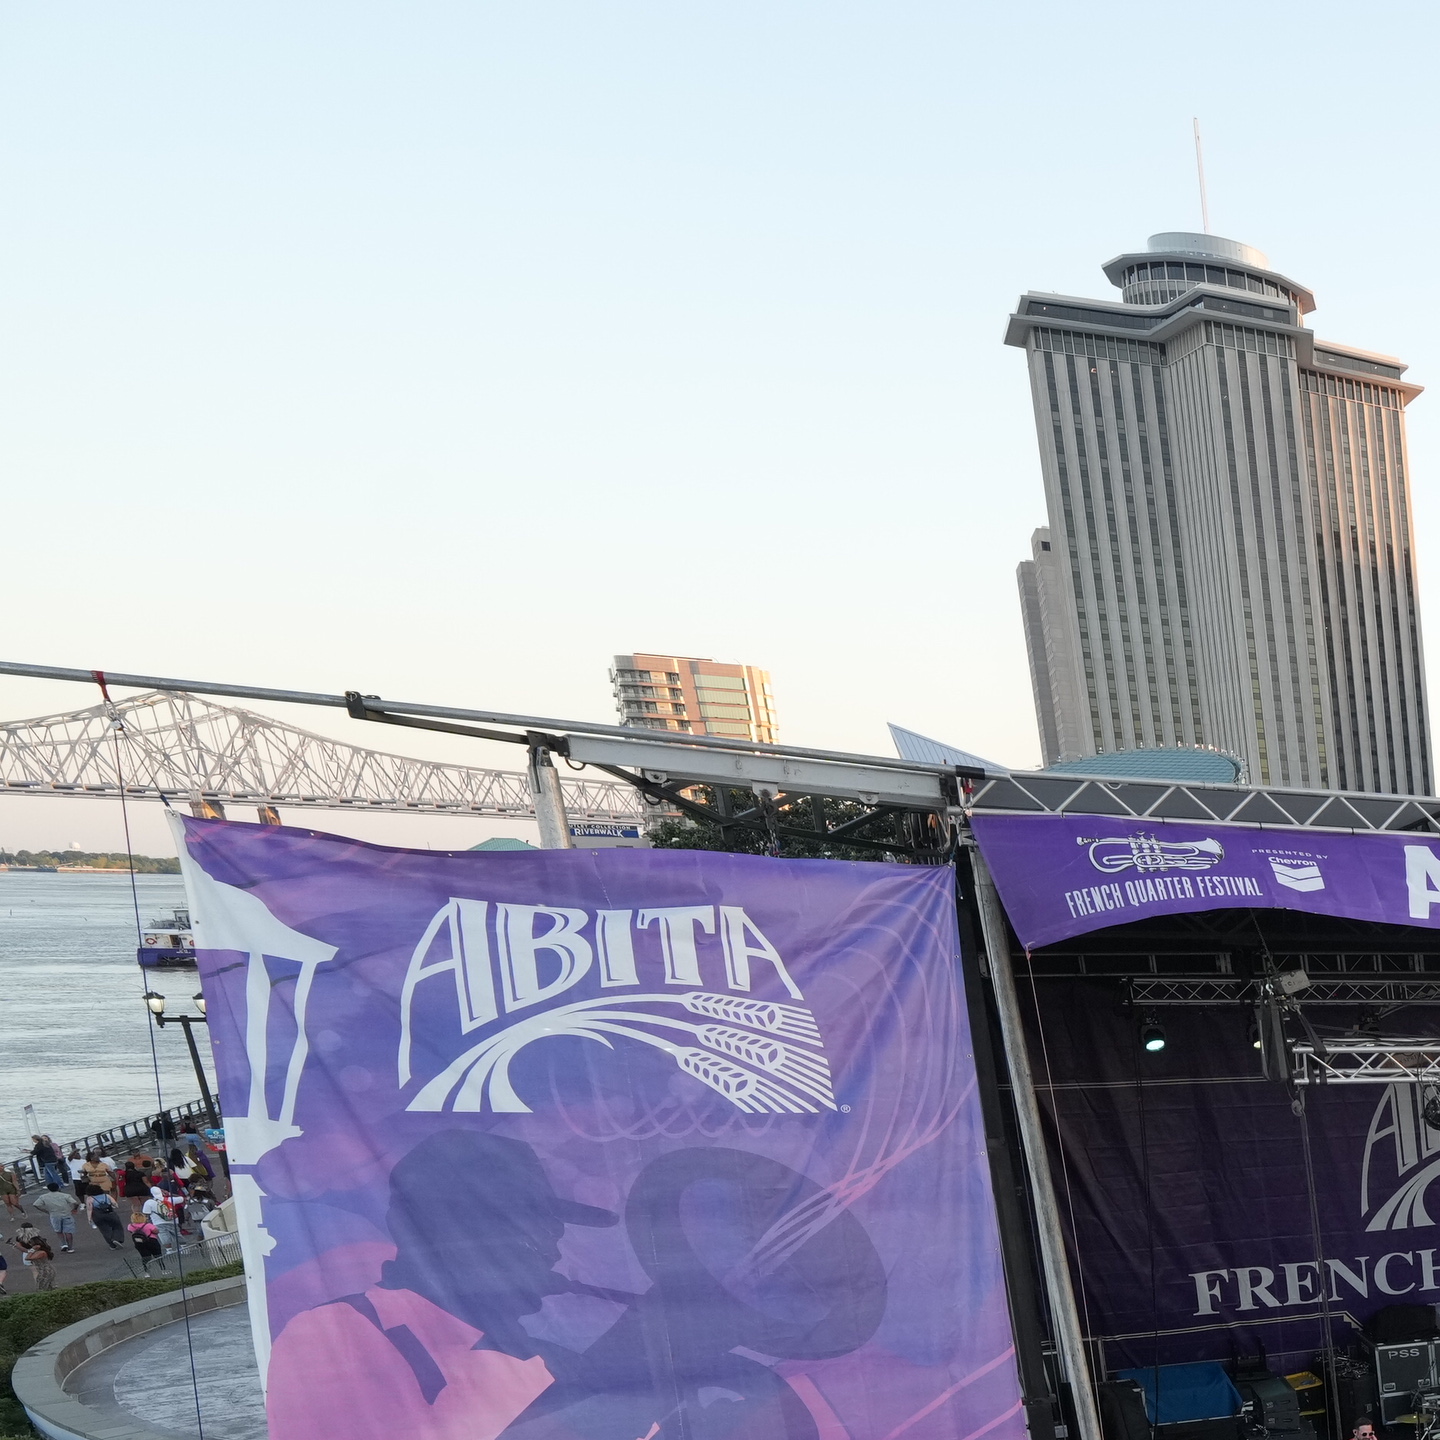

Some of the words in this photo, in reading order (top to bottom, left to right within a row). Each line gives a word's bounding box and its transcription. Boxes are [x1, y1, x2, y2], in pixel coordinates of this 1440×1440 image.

[574, 828, 624, 838] RIVERWALK
[1252, 848, 1313, 858] PRESENTED
[1268, 856, 1318, 867] Chevron
[1065, 882, 1125, 918] FRENCH
[1125, 876, 1195, 908] QUARTER
[1196, 876, 1264, 898] FESTIVAL
[399, 897, 805, 1089] ABITA
[1388, 1348, 1420, 1360] PSS
